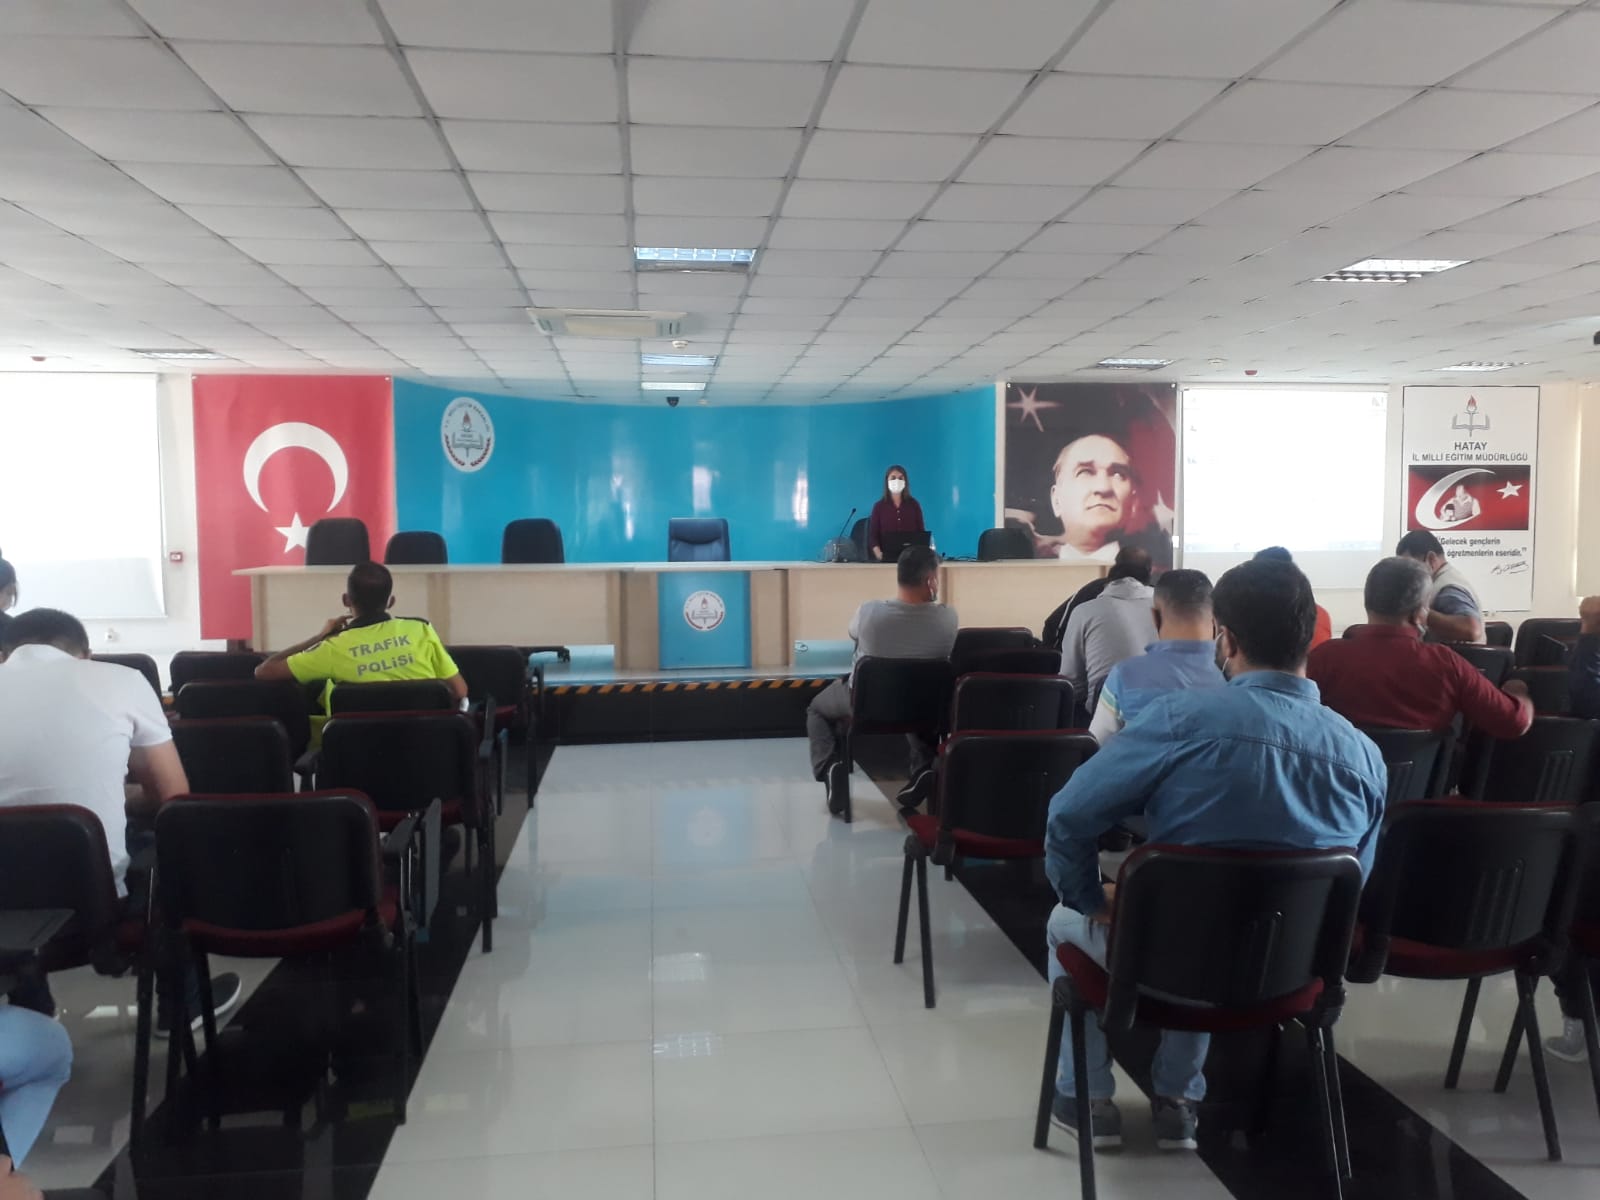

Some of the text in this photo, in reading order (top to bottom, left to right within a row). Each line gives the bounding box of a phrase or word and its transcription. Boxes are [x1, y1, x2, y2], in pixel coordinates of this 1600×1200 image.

[1454, 441, 1488, 451] HATAY
[1412, 452, 1420, 461] İL
[1445, 452, 1473, 461] EĞİTİM
[1475, 452, 1528, 461] MÜDÜRLÜĞÜ
[1469, 537, 1501, 546] gençlerin
[348, 635, 411, 657] TRAFİK
[357, 653, 414, 677] POLİSİ
